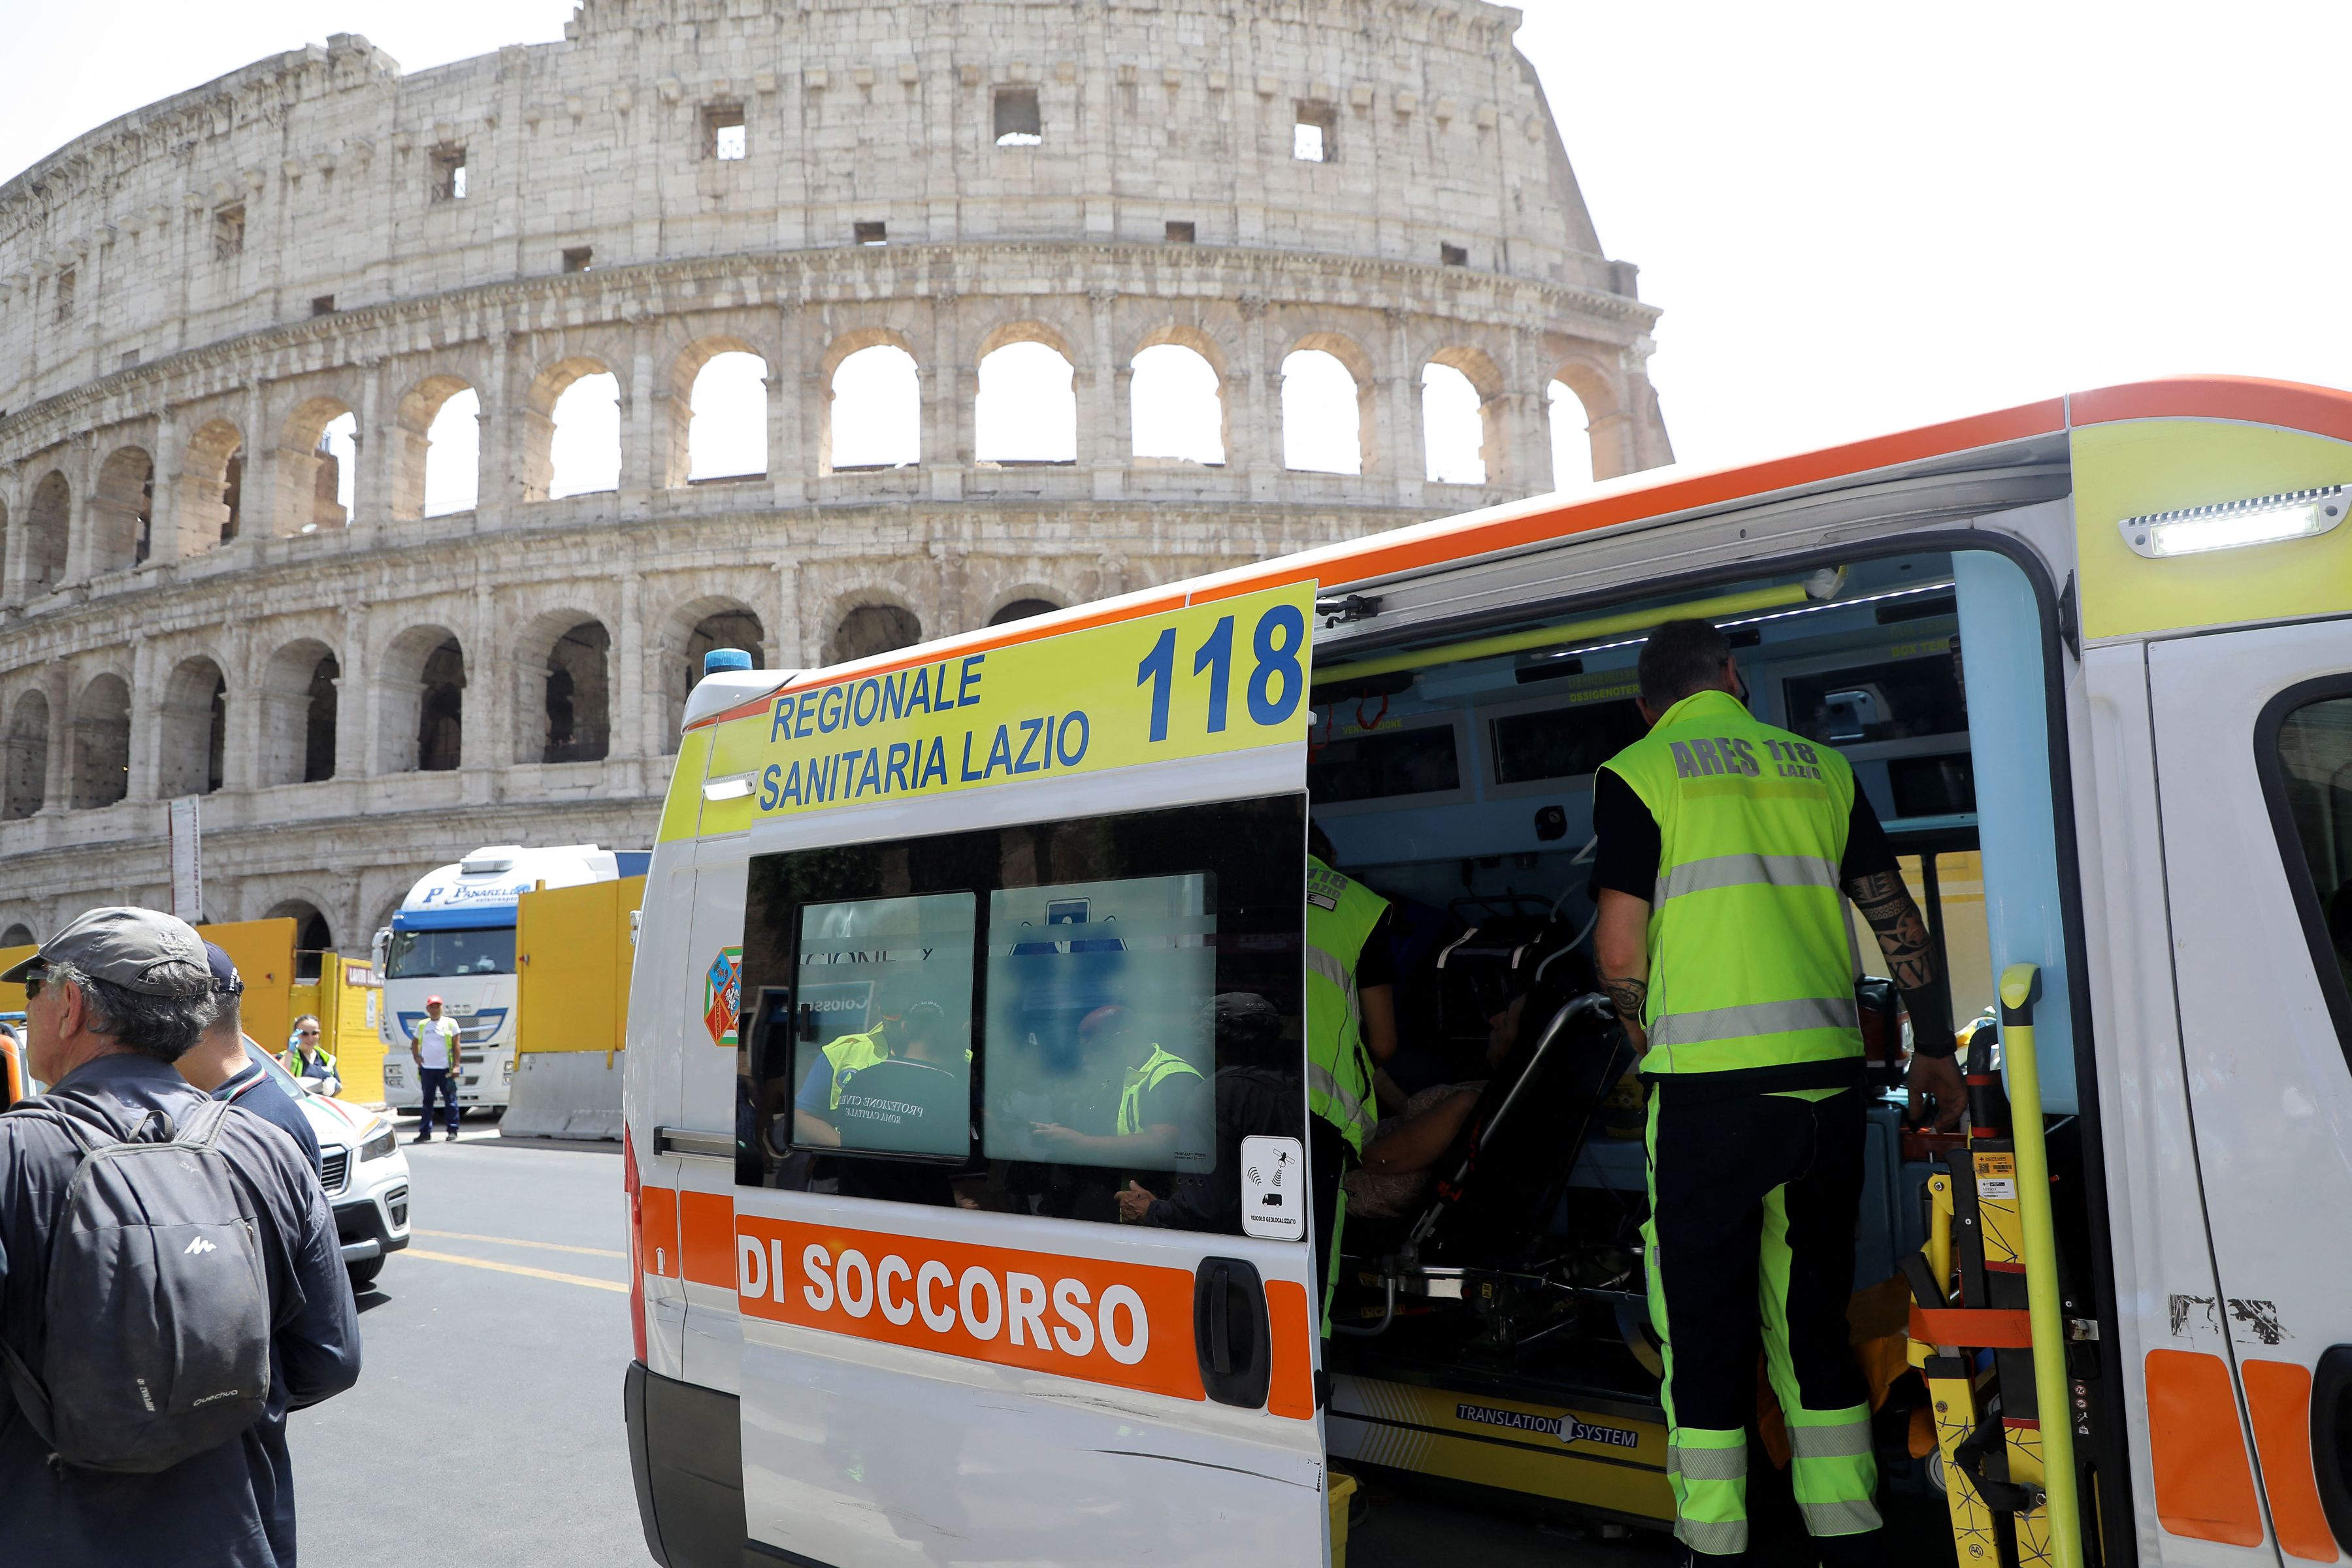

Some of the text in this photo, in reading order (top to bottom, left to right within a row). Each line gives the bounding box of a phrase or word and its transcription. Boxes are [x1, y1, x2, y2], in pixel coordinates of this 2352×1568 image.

[1892, 643, 1917, 658] BOX
[1137, 604, 1304, 743] 118
[771, 654, 985, 742] REGIONALE
[760, 711, 1090, 811] SANITARIA LAZIO
[1669, 737, 1818, 779] ARES 118
[1777, 763, 1821, 779] LAZIO
[1309, 883, 1341, 899] AZIO
[158, 933, 192, 945] BOSS
[738, 1233, 1149, 1365] DI SOCCORSO
[193, 1390, 238, 1406] Quechua
[1459, 1405, 1636, 1447] TRANSLATION SYSTEM
